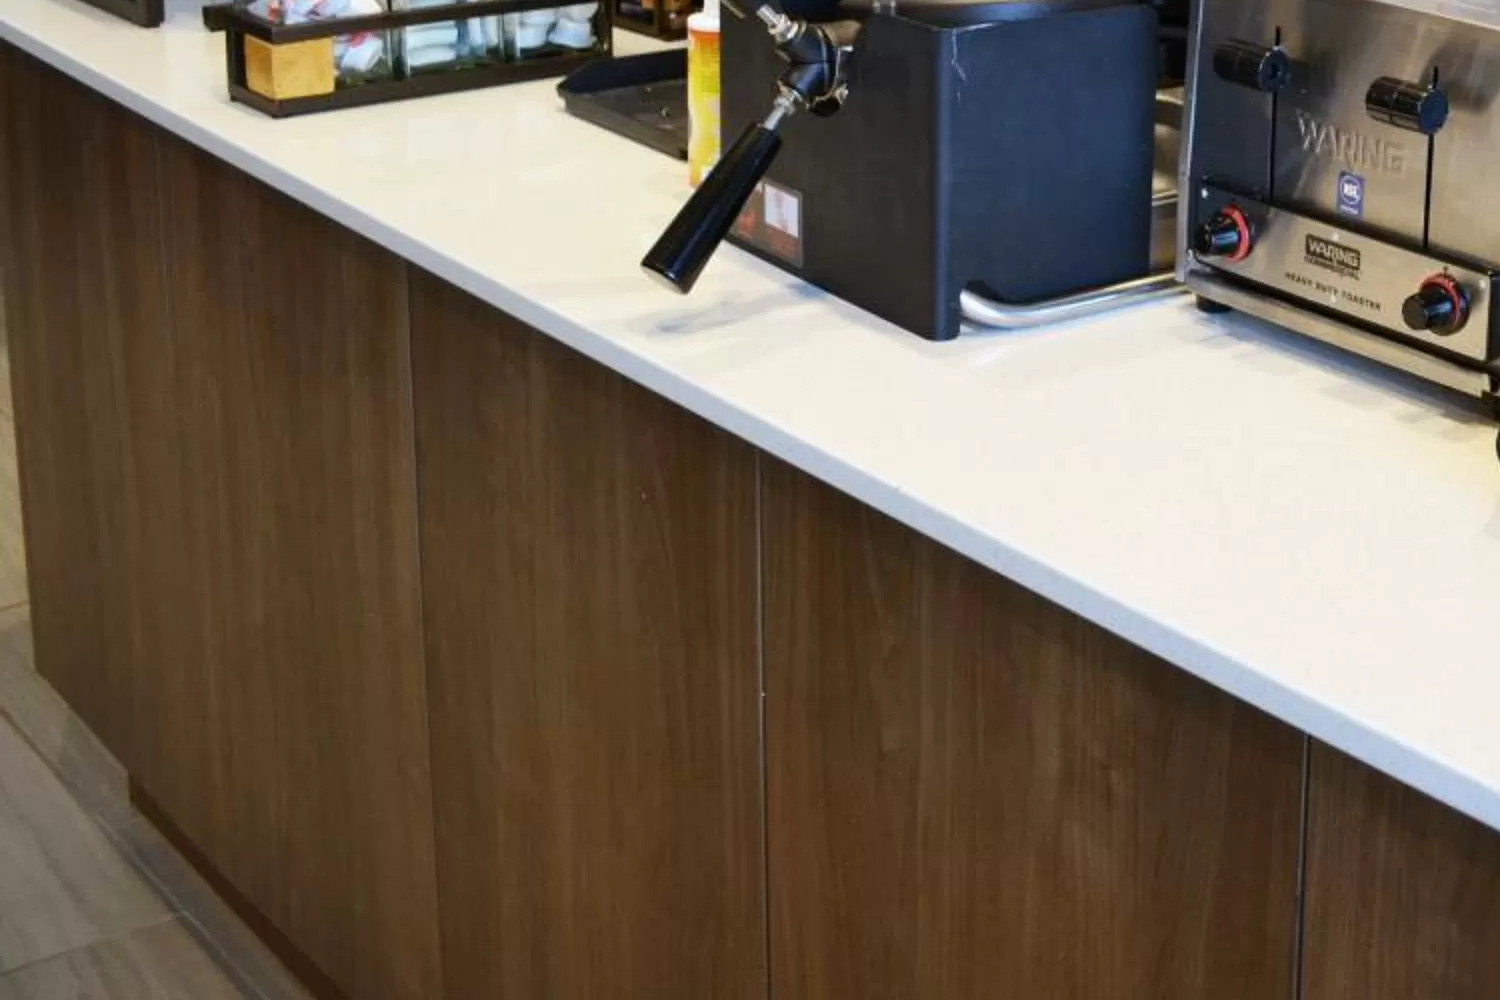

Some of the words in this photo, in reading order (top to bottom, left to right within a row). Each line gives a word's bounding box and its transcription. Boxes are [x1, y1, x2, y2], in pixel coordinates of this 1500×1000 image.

[1297, 110, 1405, 173] WARING
[1308, 236, 1361, 267] WARING
[1284, 271, 1312, 289] HEAVY
[1315, 280, 1339, 296] DUTY
[1341, 287, 1382, 311] TOASTER
